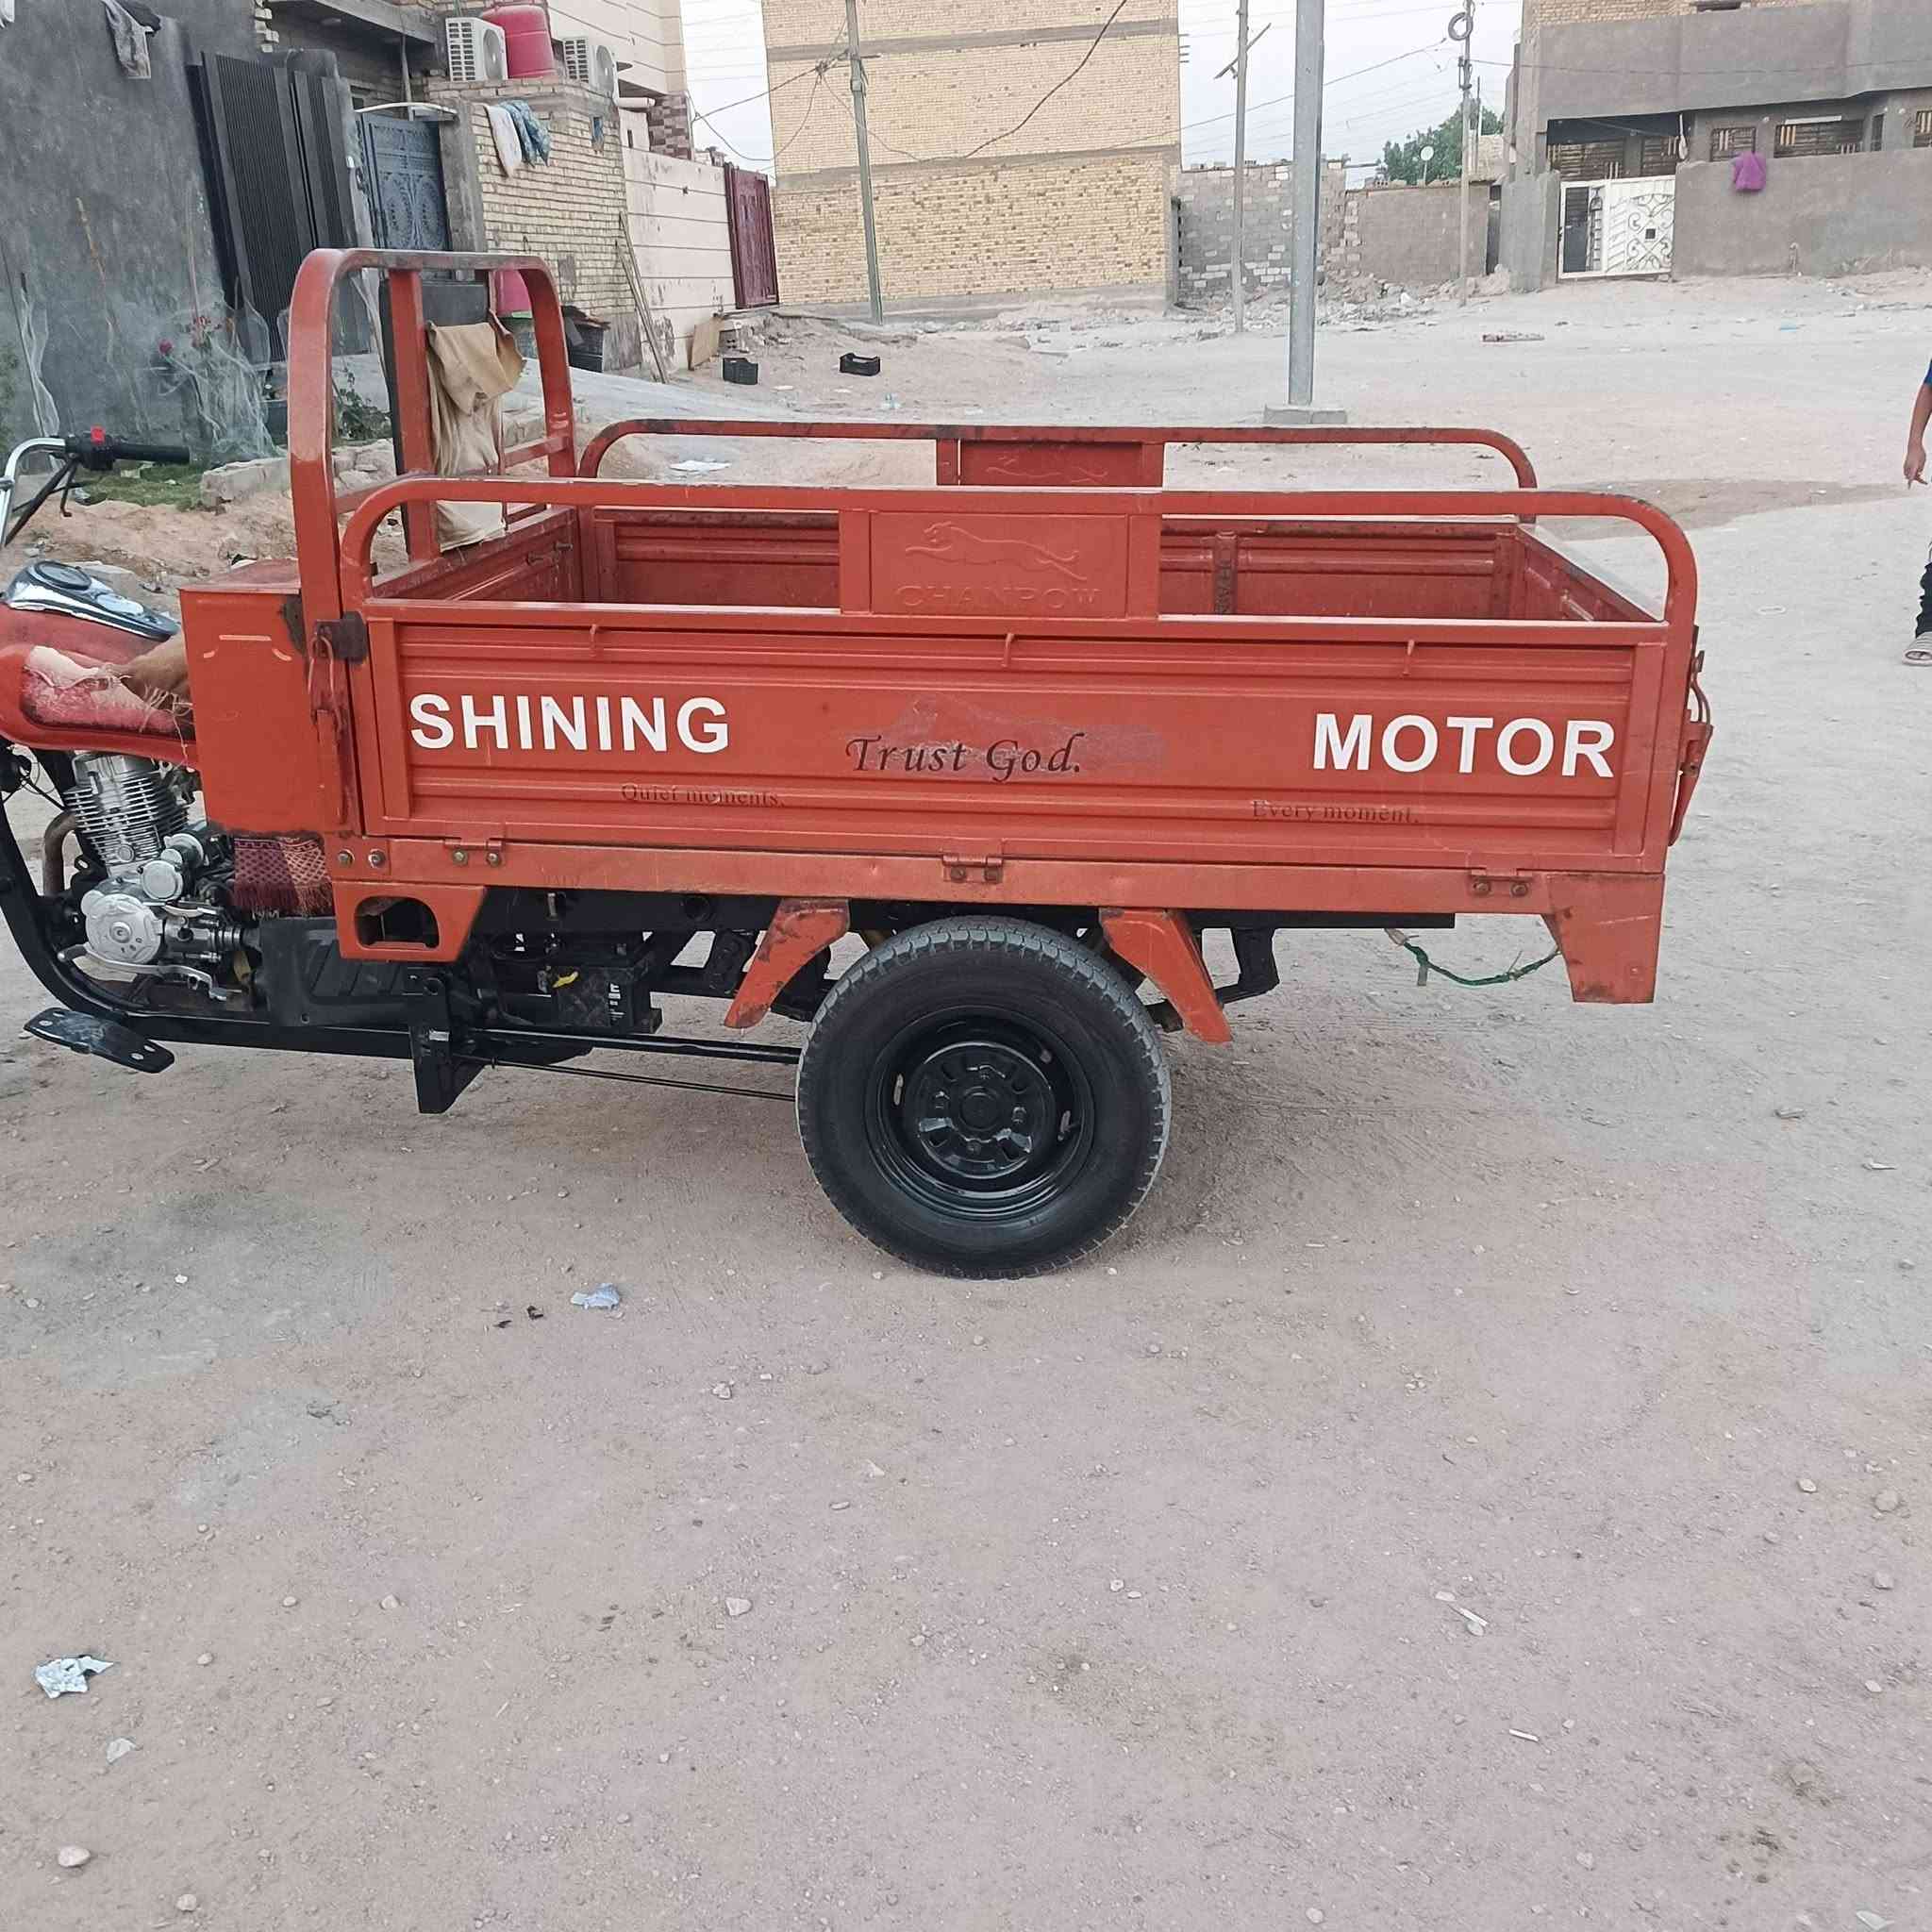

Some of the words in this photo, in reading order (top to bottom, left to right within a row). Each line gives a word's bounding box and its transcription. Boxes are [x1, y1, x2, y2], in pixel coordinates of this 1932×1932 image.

[409, 692, 729, 754] SHINING
[1312, 713, 1615, 778] MOTOR
[845, 735, 967, 772] Trust
[986, 732, 1085, 783] God.
[1251, 799, 1316, 822] Every
[1323, 804, 1420, 824] moment.
